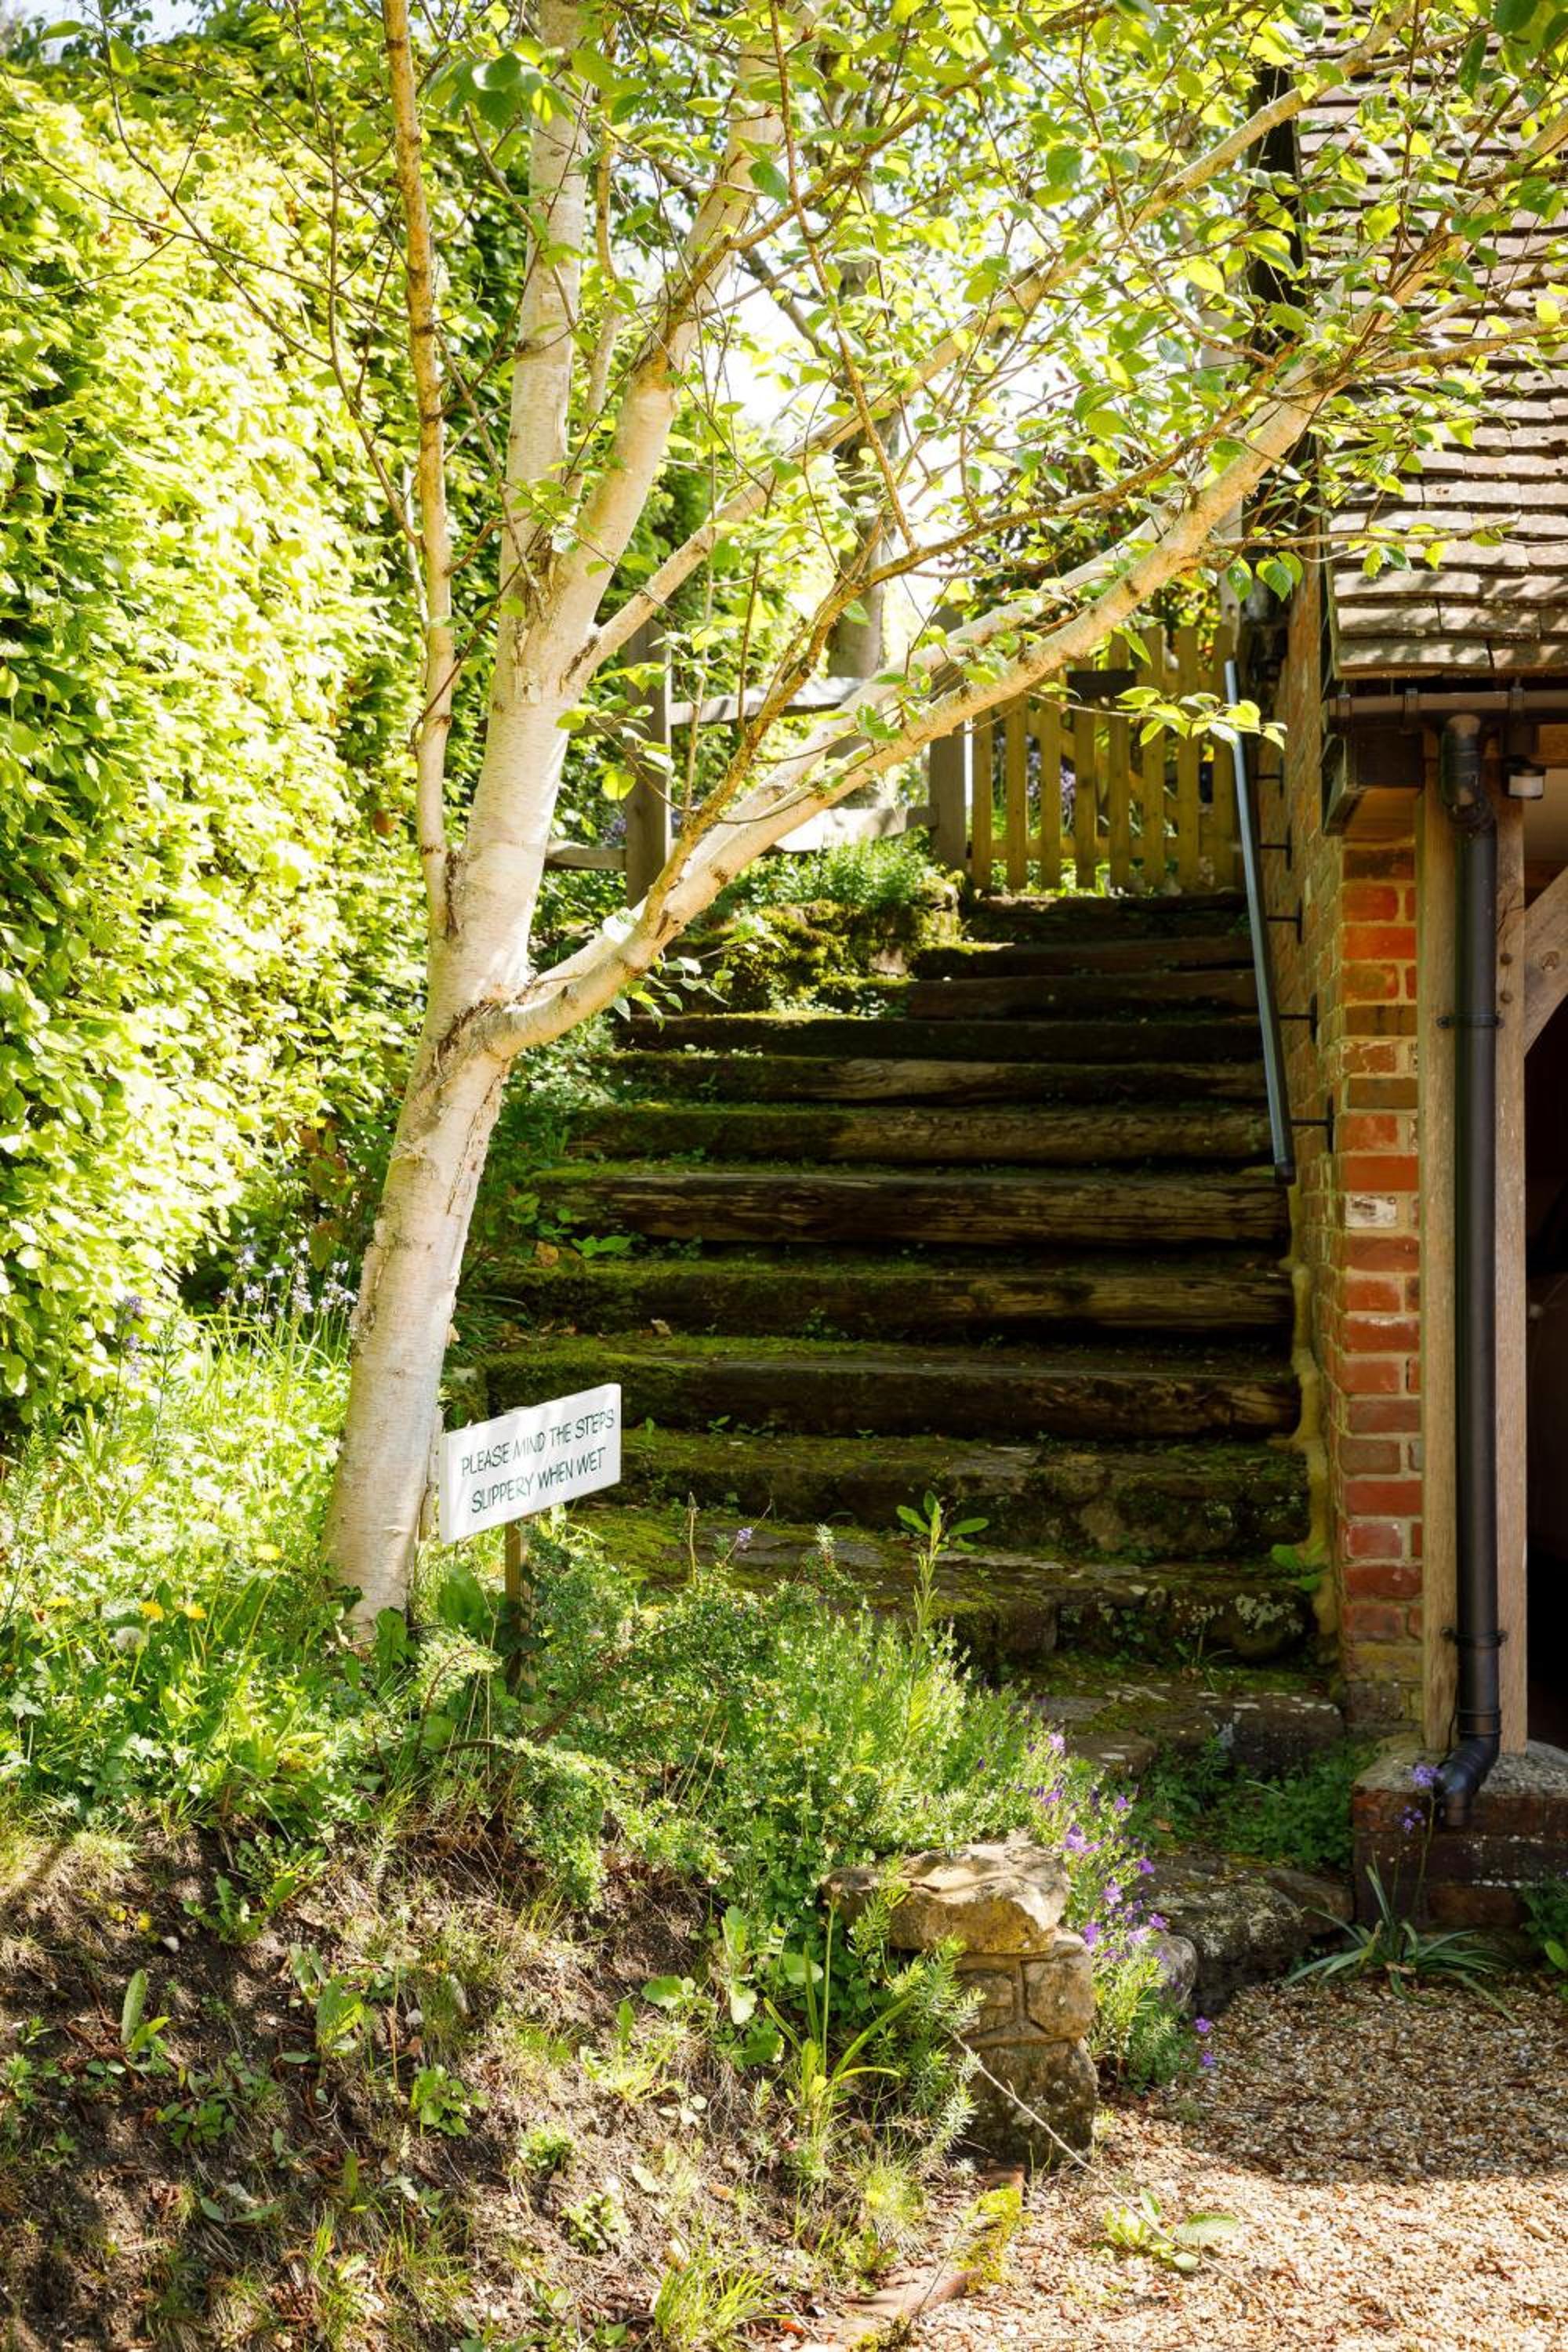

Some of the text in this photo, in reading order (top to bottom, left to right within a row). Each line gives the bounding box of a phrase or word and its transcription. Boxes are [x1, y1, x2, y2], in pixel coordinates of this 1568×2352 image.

[461, 1409, 615, 1478] PLEASE MIND THE STEPS
[471, 1446, 607, 1514] SLIPPERY WHEN WET
